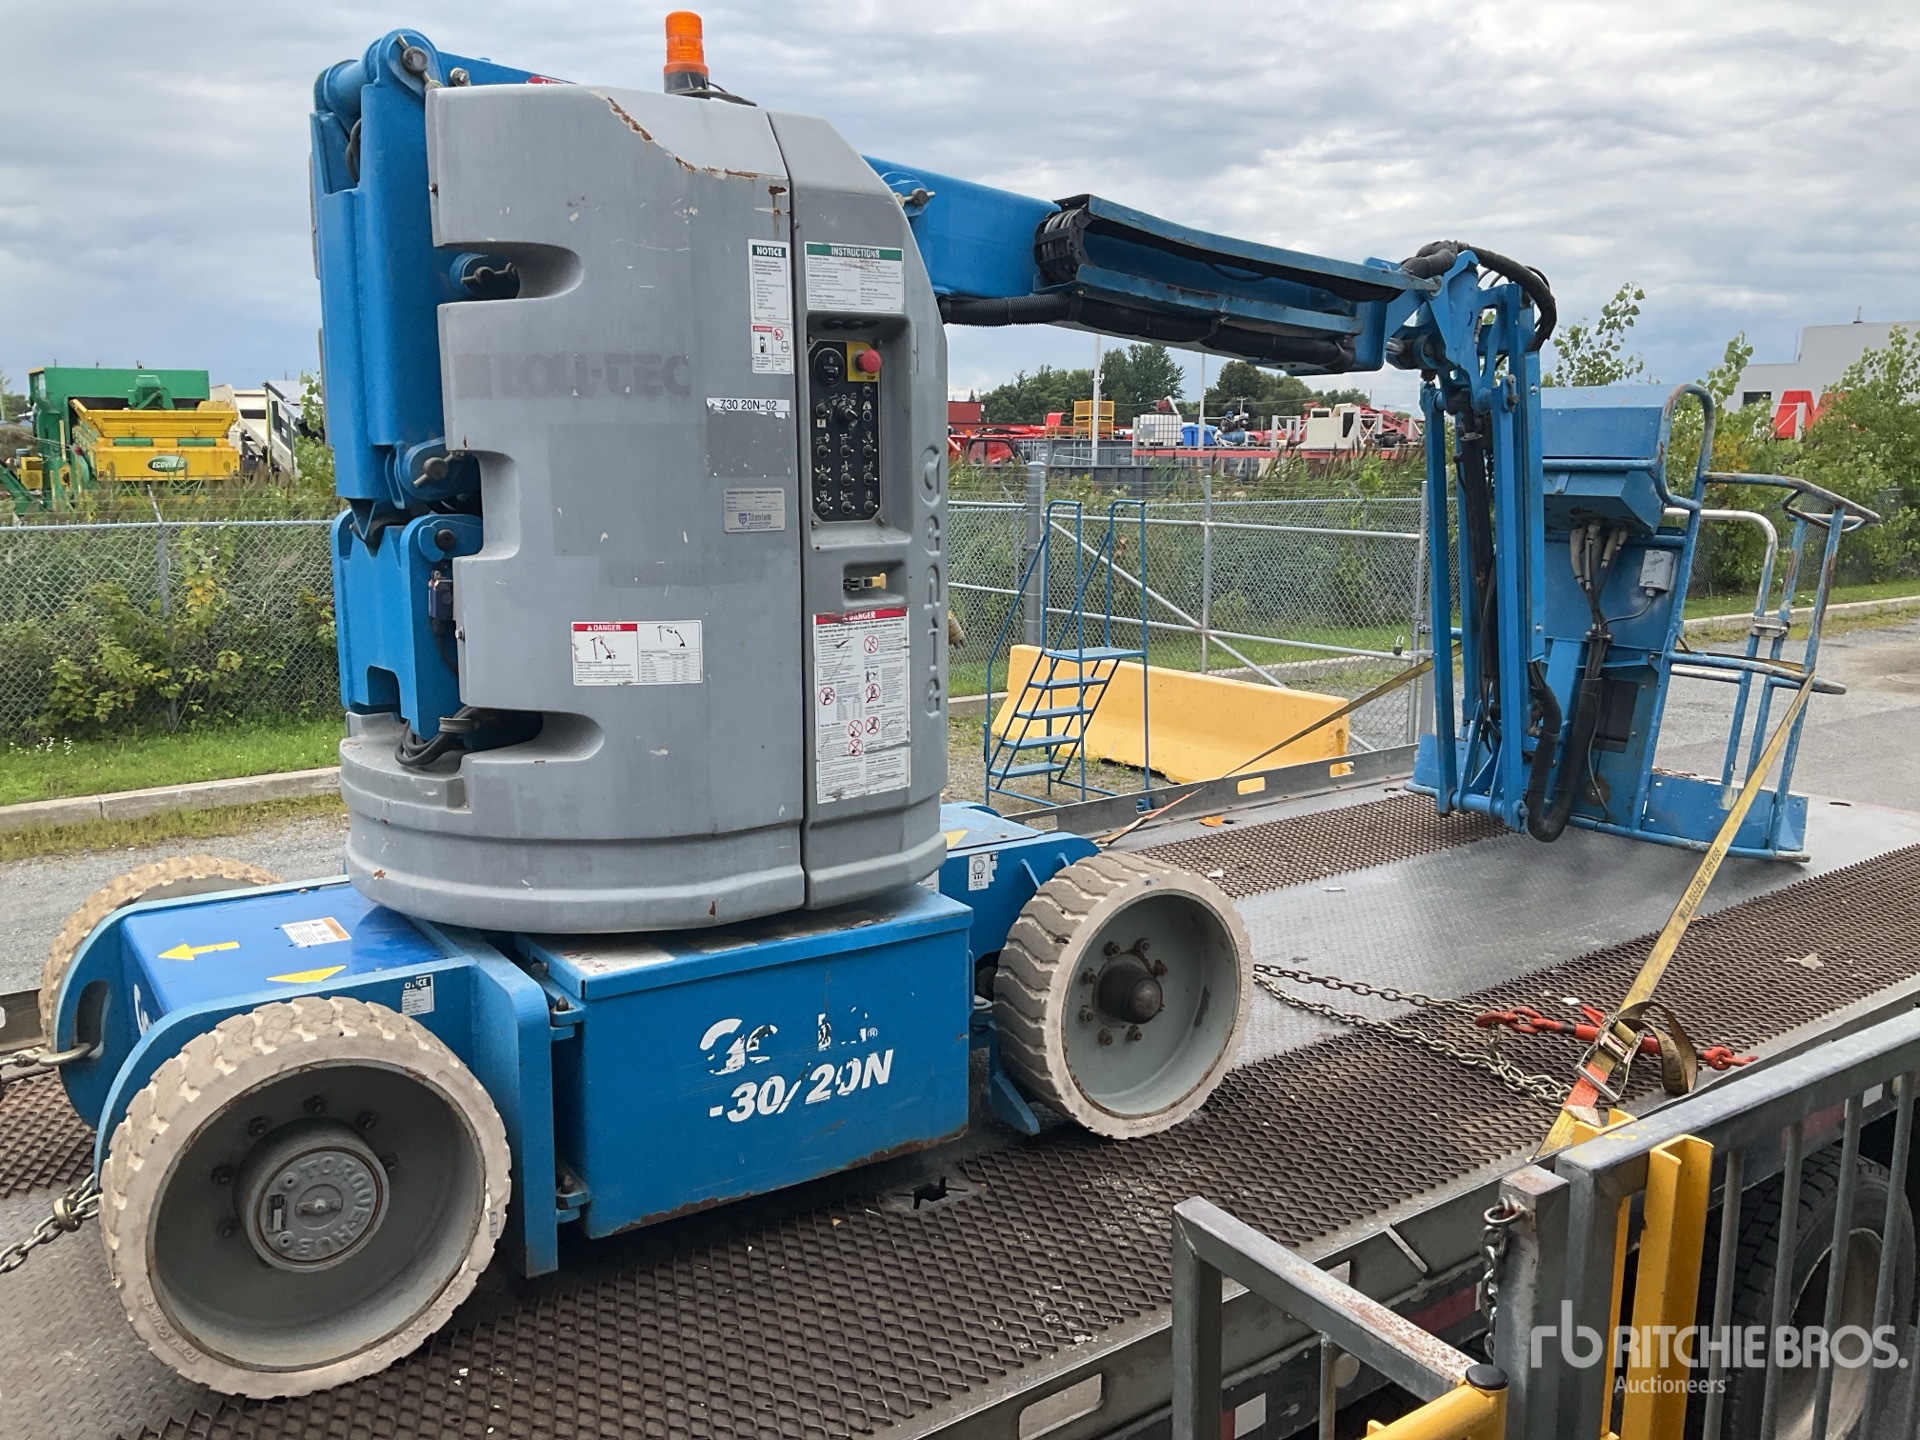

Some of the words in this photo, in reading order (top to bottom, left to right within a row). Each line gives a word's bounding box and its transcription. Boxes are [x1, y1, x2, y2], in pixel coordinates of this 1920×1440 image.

[756, 246, 783, 257] NOTICE
[830, 246, 880, 259] INSTRUCTIONS
[741, 399, 777, 411] 20N-02
